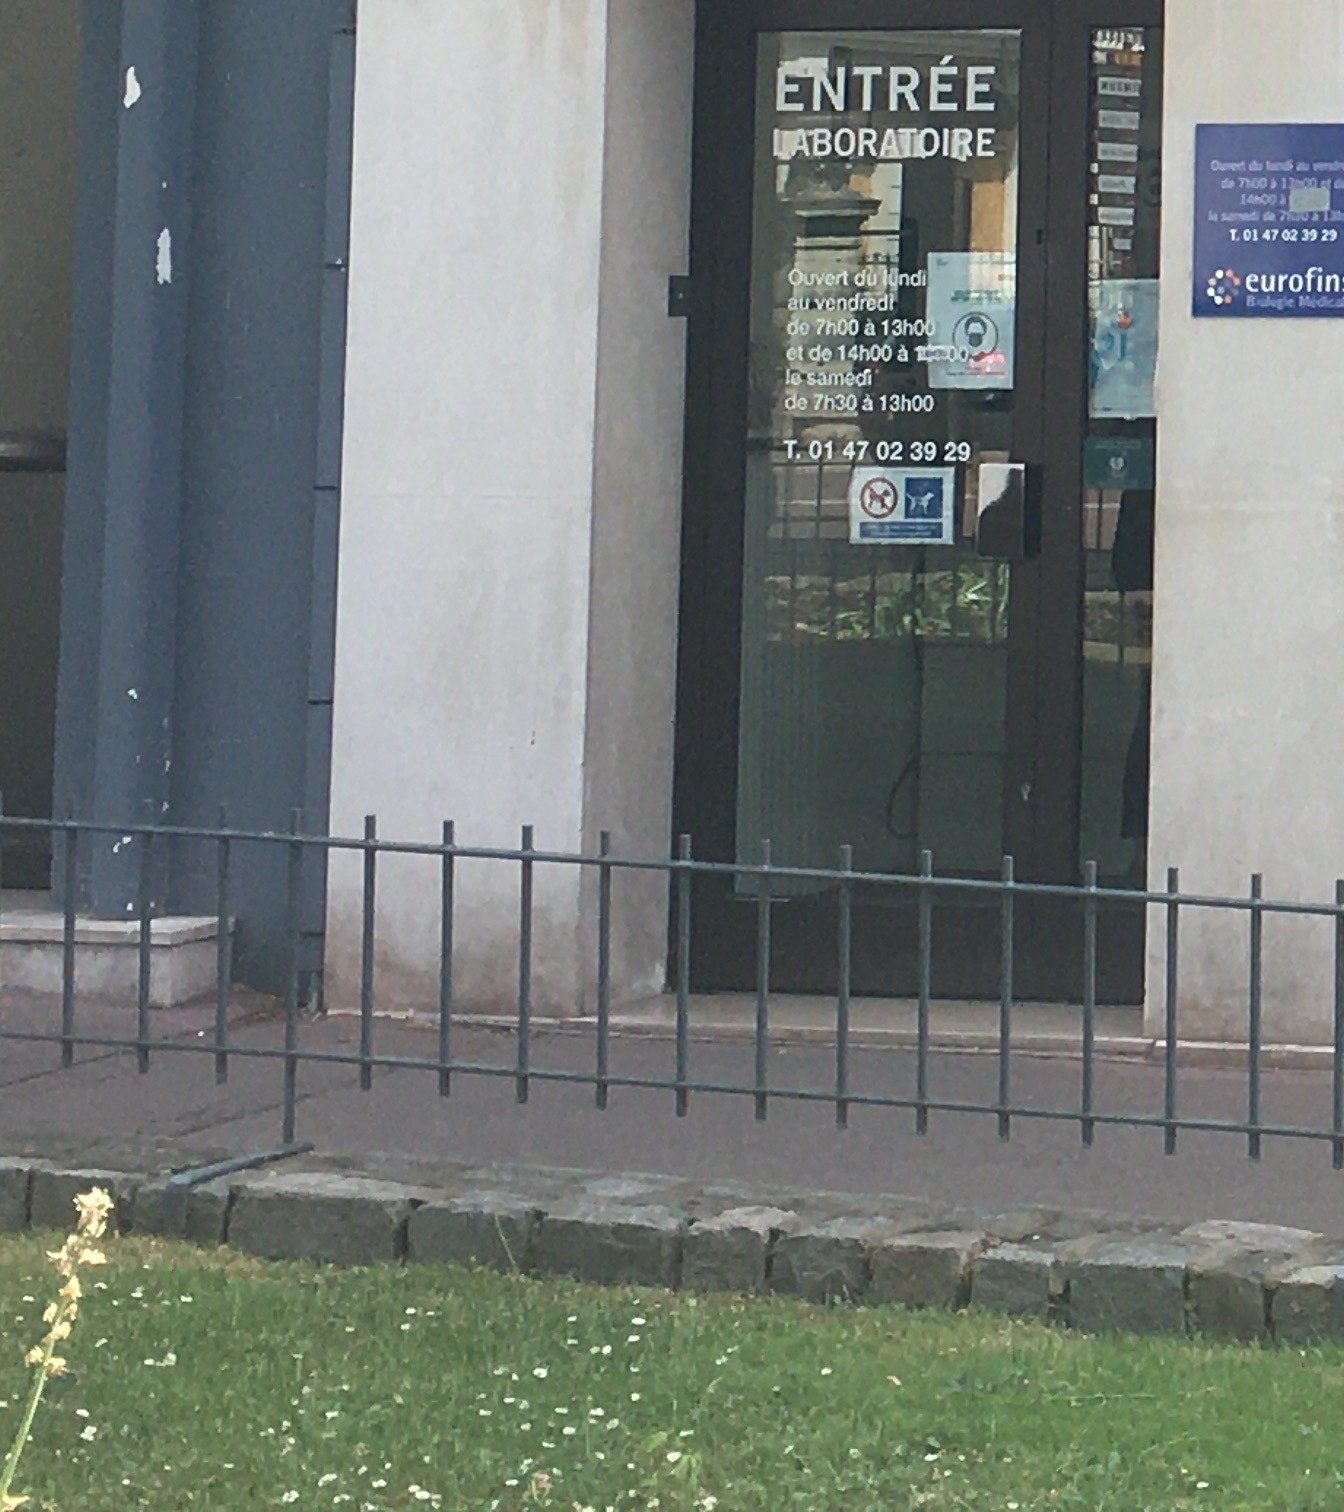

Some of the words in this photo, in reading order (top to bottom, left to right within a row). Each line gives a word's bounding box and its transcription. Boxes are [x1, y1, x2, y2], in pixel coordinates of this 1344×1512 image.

[776, 55, 996, 112] ENTRÉE
[773, 127, 996, 158] LABORATOIRE
[1229, 228, 1240, 242] T.
[1242, 228, 1258, 242] 01
[1262, 228, 1280, 242] 47
[1281, 228, 1298, 242] 02
[1301, 228, 1318, 242] 39
[1321, 228, 1338, 242] 29
[788, 268, 849, 287] Ouvert
[853, 268, 878, 287] du
[882, 268, 927, 287] lundi
[787, 296, 810, 312] au
[814, 292, 895, 312] vendredi
[786, 318, 811, 336] de
[815, 318, 860, 337] 7h00
[863, 317, 876, 337] à
[881, 318, 937, 337] 13h00
[785, 345, 804, 362] et
[808, 344, 833, 362] de
[837, 344, 893, 363] 14h00
[896, 343, 909, 362] à
[785, 368, 801, 386] le
[806, 368, 873, 387] samedi
[784, 393, 809, 411] de
[812, 393, 858, 412] 7h30
[861, 393, 874, 412] à
[879, 394, 935, 413] 13h00
[783, 439, 801, 460] T.
[808, 439, 834, 460] 01
[842, 440, 870, 462] 47
[876, 440, 907, 462] 02
[909, 440, 937, 462] 39
[943, 441, 972, 463] 29
